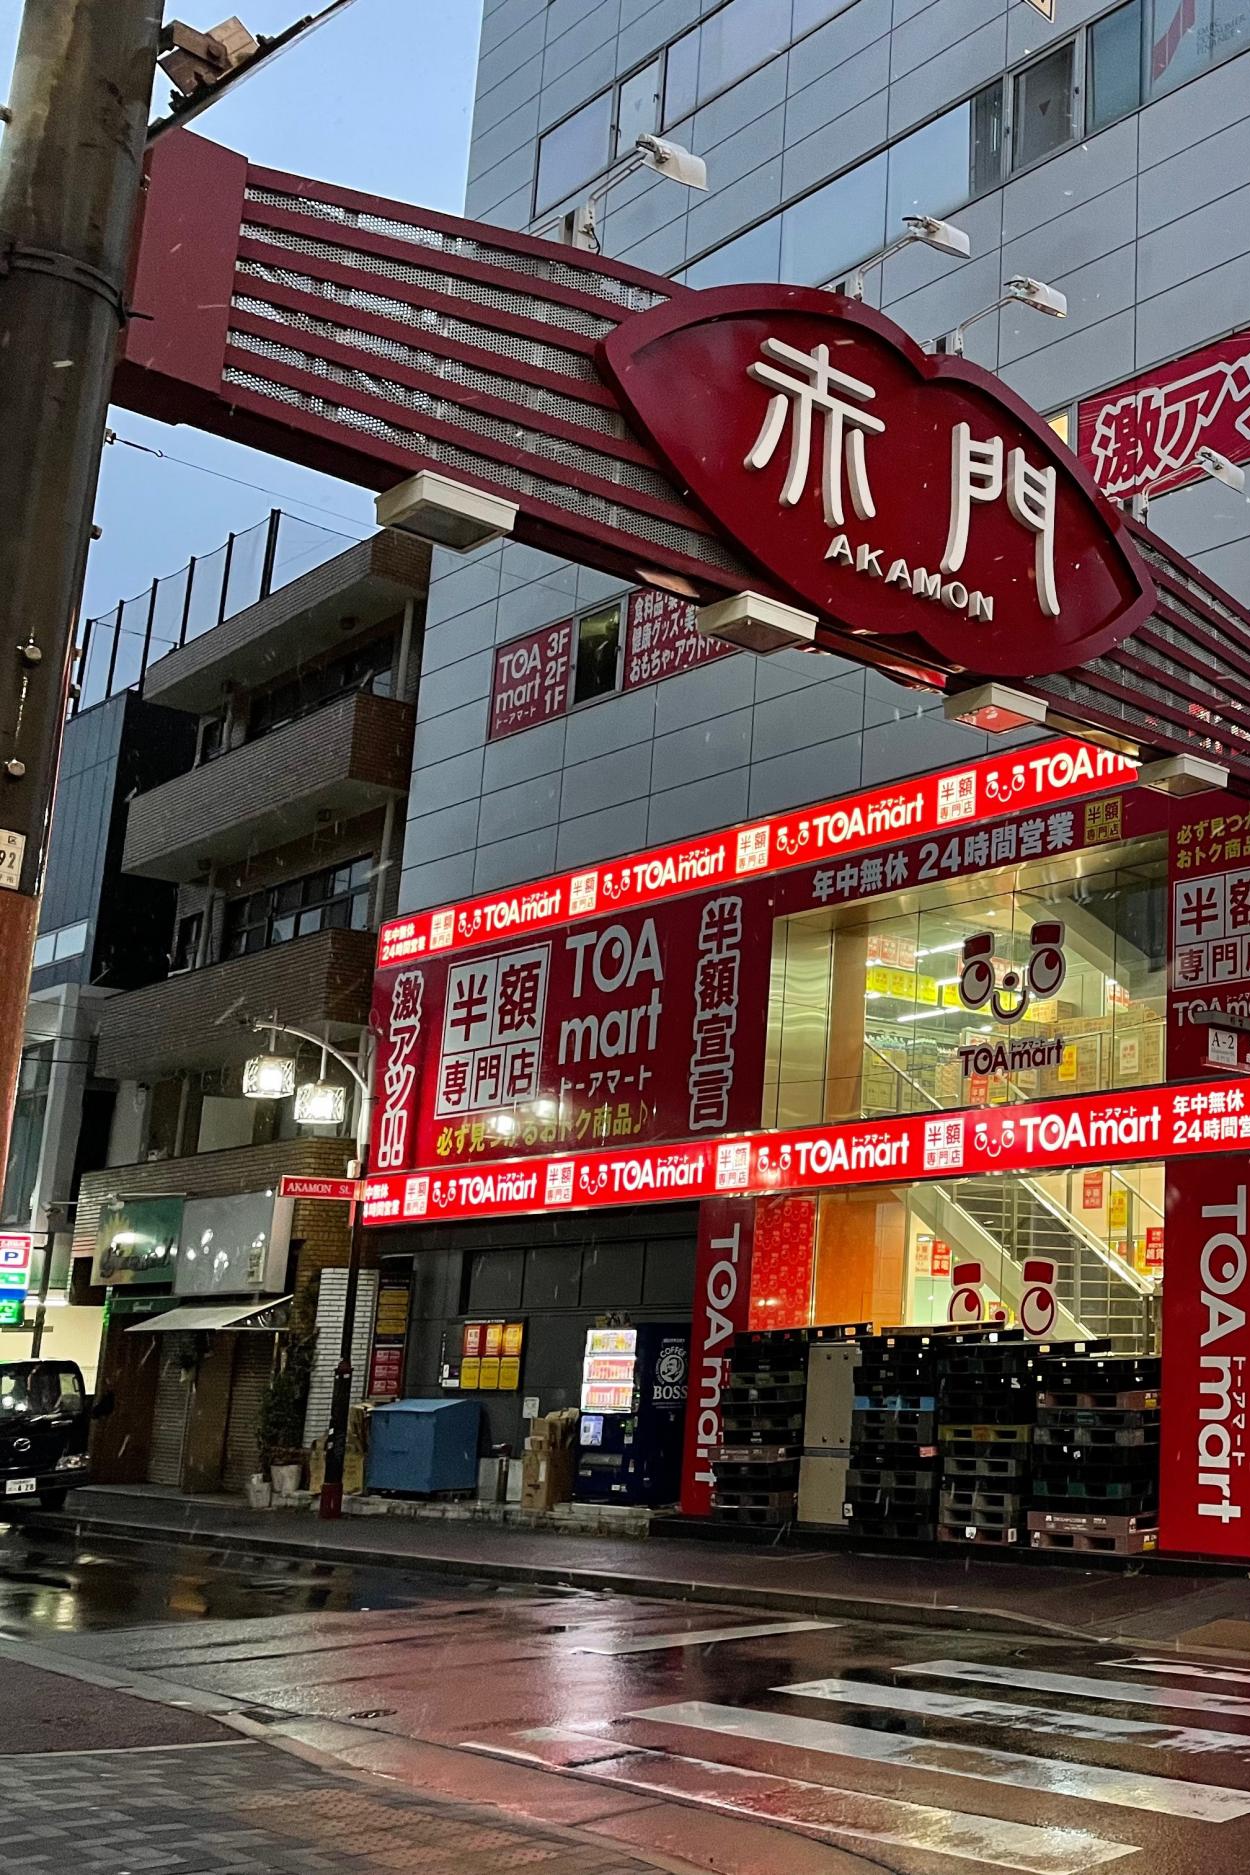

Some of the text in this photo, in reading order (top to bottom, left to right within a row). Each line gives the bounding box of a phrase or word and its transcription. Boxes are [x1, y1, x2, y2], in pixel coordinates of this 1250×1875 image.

[743, 337, 1061, 617] 赤門
[824, 534, 994, 622] AKAMON
[548, 627, 571, 658] 3F
[632, 603, 697, 655] 健康グッズ・美
[500, 643, 542, 684] TOA
[544, 656, 568, 687] 2F
[495, 671, 542, 714] mart
[544, 685, 566, 714] 1F
[495, 706, 537, 730] トーアマート
[1030, 746, 1143, 793] TOAm
[940, 776, 974, 800] 半額
[813, 793, 924, 847] TOAmart
[939, 800, 974, 821] 専門店
[1086, 801, 1121, 825] 半額
[739, 830, 767, 850] 半額
[1084, 823, 1120, 844] 専門店
[633, 846, 726, 893] TOAmart
[812, 811, 1075, 902] 年中無休 24時間営業
[484, 889, 562, 931] TOAmart
[566, 917, 664, 998] TOA
[451, 959, 542, 1043] 半額
[688, 896, 743, 1130] 半額宣言
[558, 987, 662, 1066] mart
[1211, 1031, 1235, 1050] A-2
[441, 1045, 537, 1106] 専門店
[960, 1041, 1064, 1076] TOAmart
[559, 1064, 653, 1096] トーアマート
[1172, 1089, 1244, 1116] 年中無休
[927, 1121, 963, 1147] 半額
[1025, 1105, 1162, 1153] TOAmart
[798, 1132, 910, 1174] TOAmart
[926, 1147, 961, 1168] 専門店
[287, 1181, 333, 1194] AKAMON
[459, 1172, 538, 1205] TOAmart
[611, 1155, 705, 1192] TOAmart
[363, 1200, 400, 1217] 時間営業
[4, 1251, 19, 1262] P
[660, 1346, 687, 1358] COFFEE
[1198, 1184, 1247, 1524] TOAmart
[653, 1385, 688, 1400] BOSS
